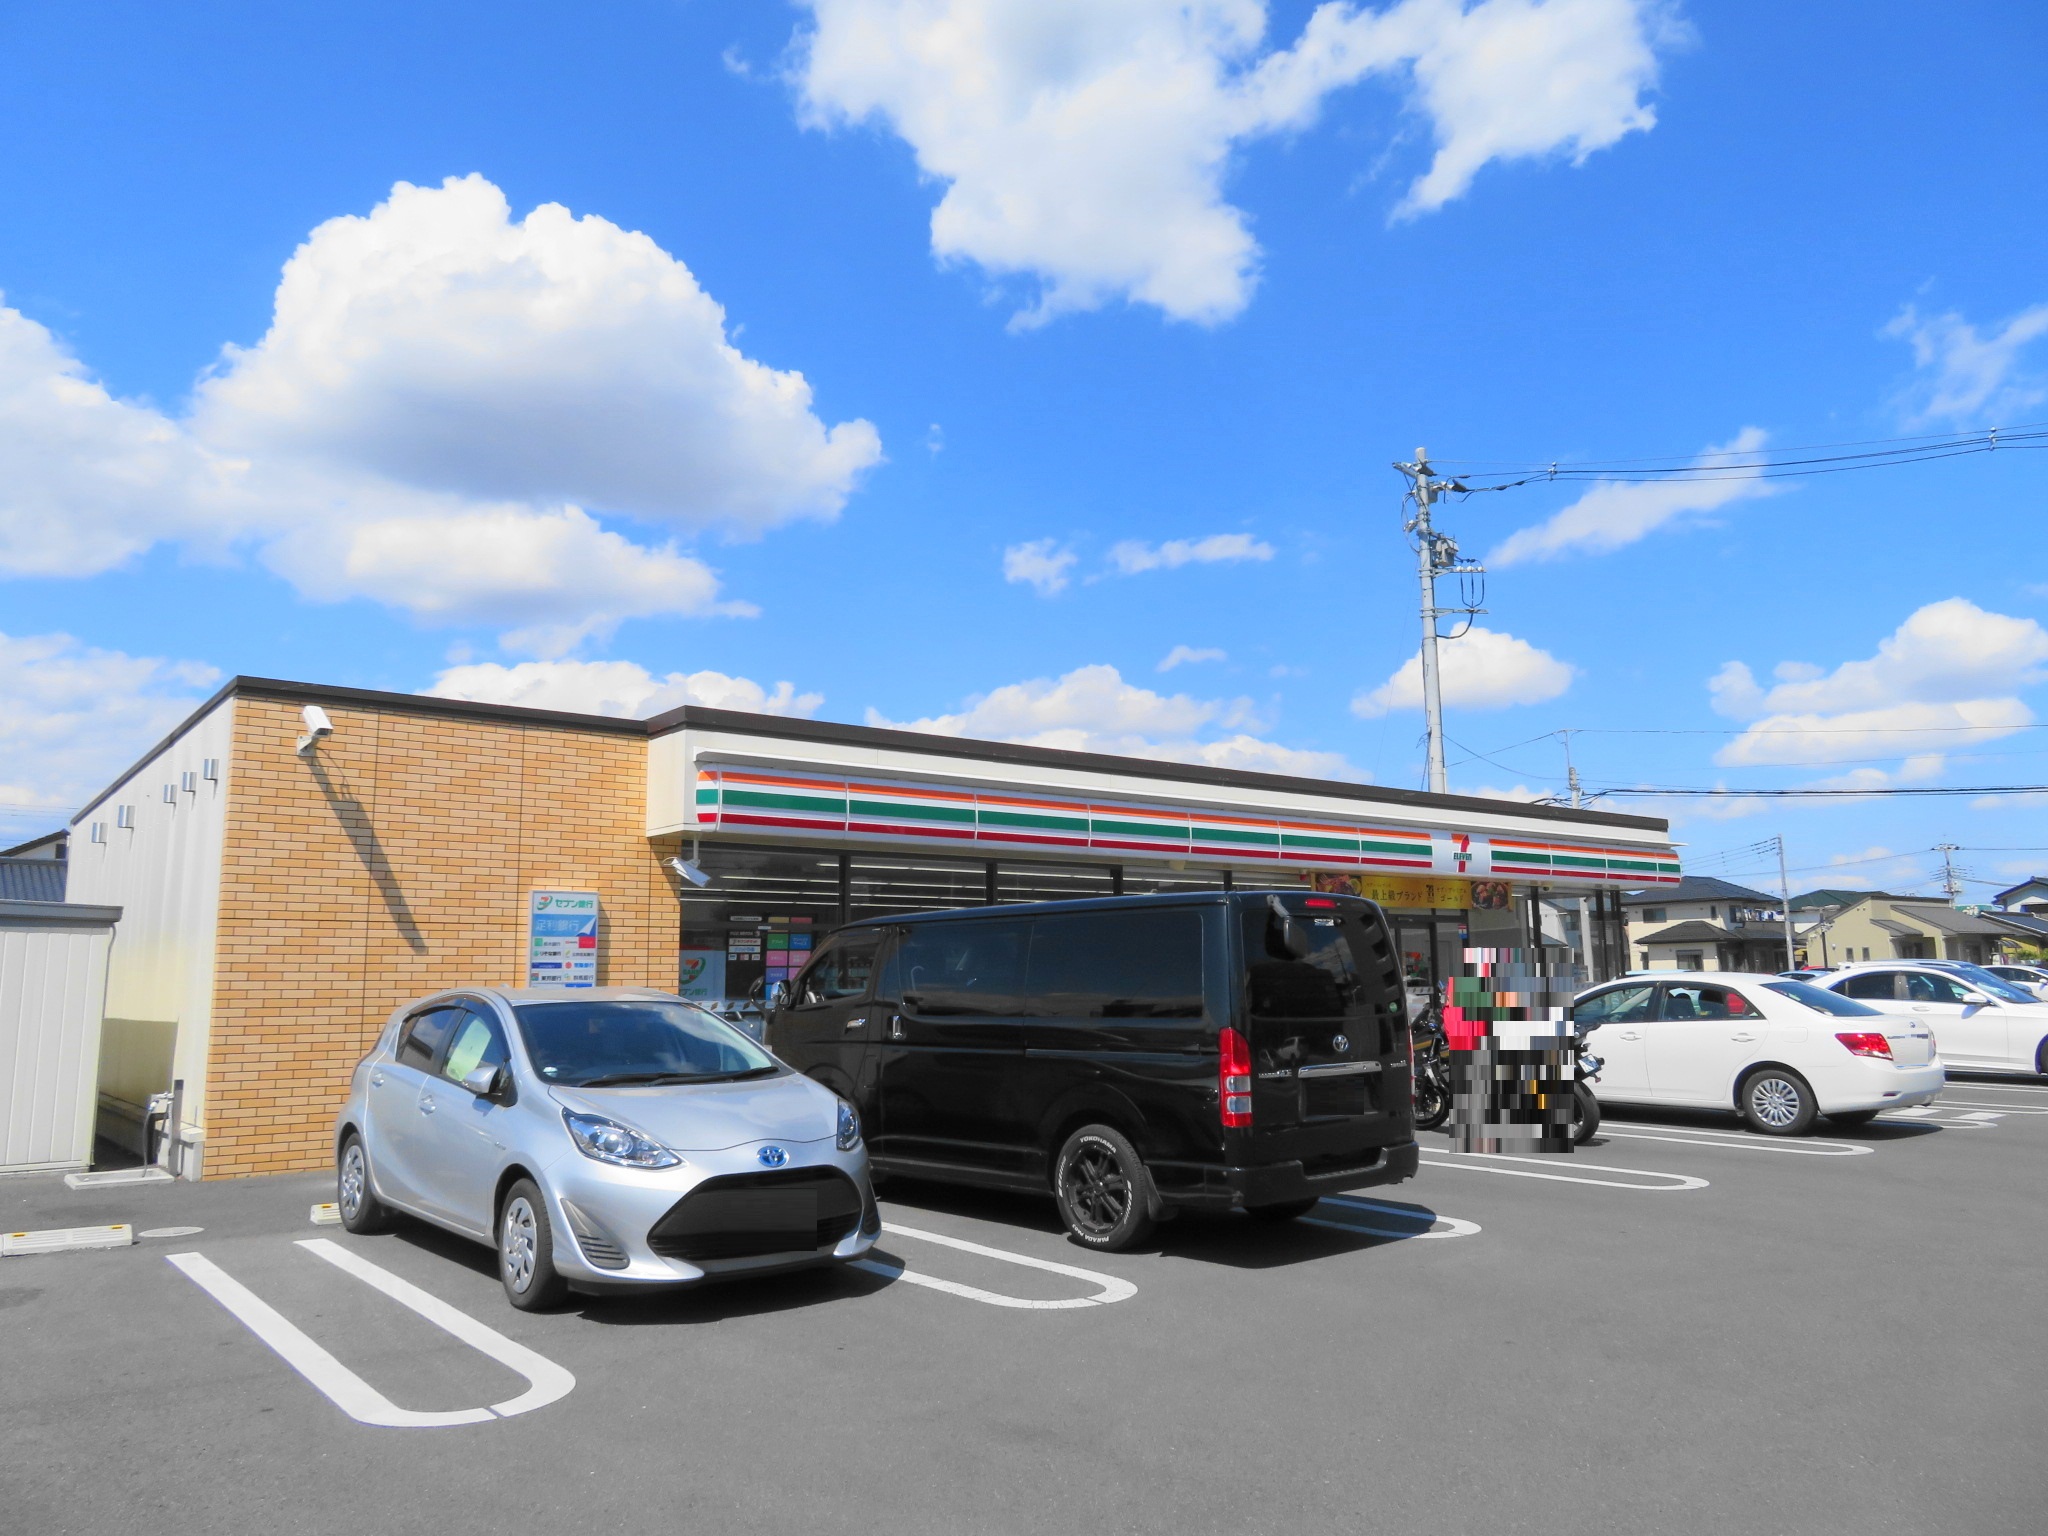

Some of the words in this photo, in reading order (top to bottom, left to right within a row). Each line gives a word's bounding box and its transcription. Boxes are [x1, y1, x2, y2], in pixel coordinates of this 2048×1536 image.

[1371, 888, 1423, 902] 最上級ブランド
[1440, 894, 1464, 903] ゴールド
[555, 899, 594, 908] セブン銀行
[535, 919, 580, 932] 足利銀行
[680, 988, 708, 996] ブン銀行
[1080, 1135, 1117, 1154] YOKOHAMA
[1084, 1235, 1110, 1243] PARADA
